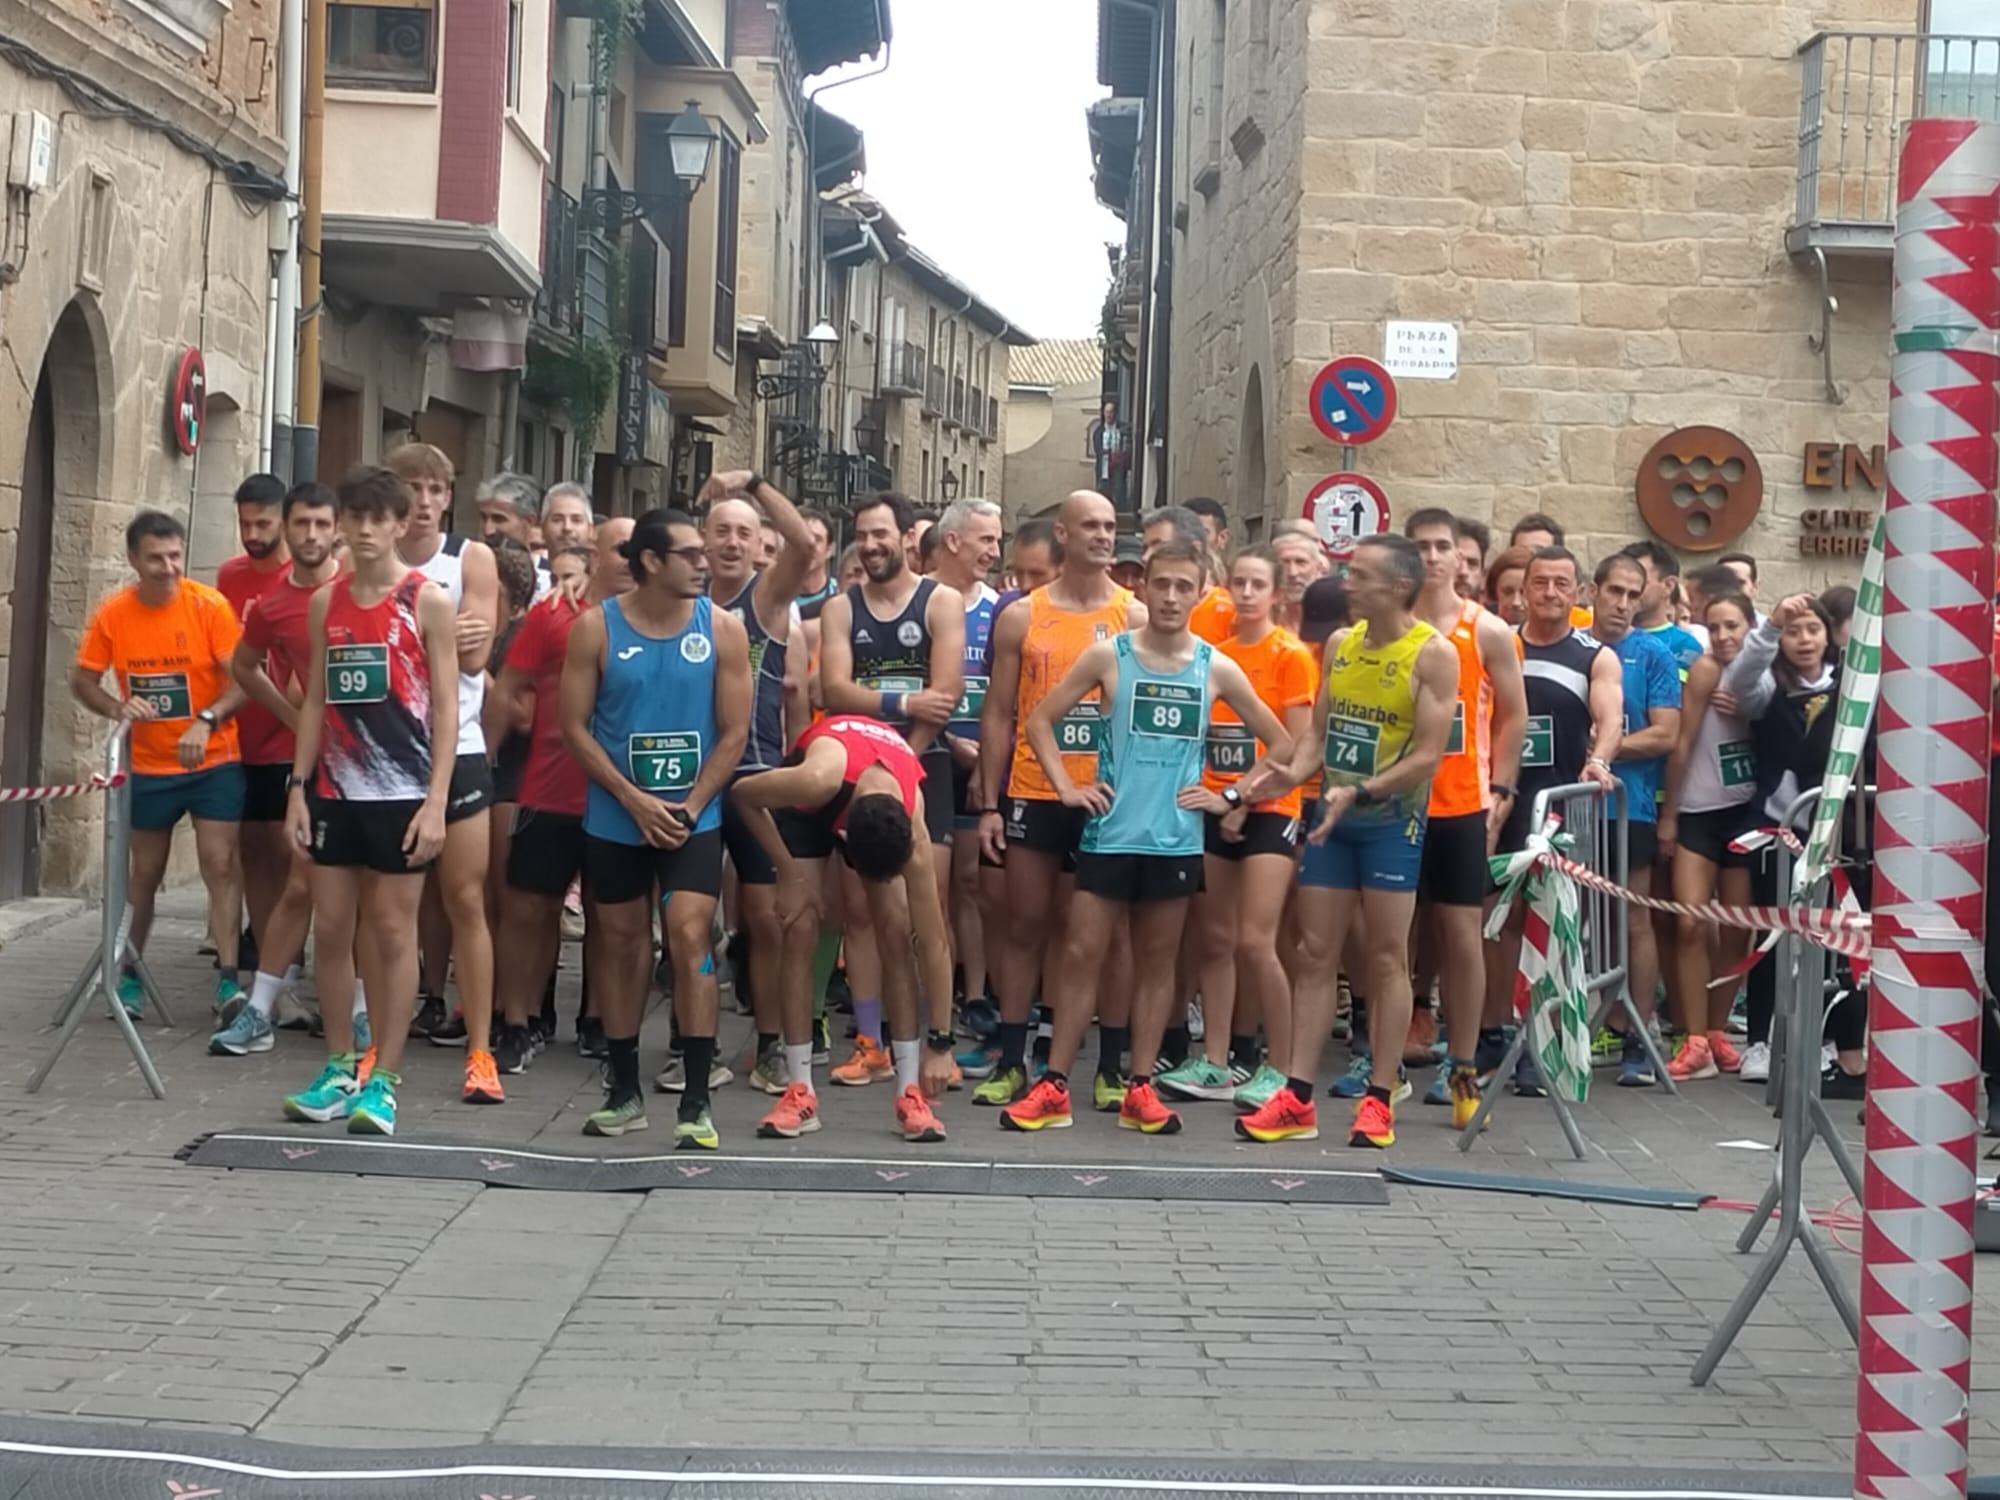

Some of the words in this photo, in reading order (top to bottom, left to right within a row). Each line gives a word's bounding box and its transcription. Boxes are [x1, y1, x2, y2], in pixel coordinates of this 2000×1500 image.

[1396, 330, 1448, 341] PLAZA
[1399, 345, 1412, 354] DE
[624, 355, 643, 462] PRENSA
[1803, 442, 1885, 489] EN
[339, 670, 368, 692] 99
[1152, 705, 1182, 728] 89
[1063, 724, 1091, 745] 86
[1213, 745, 1246, 766] 104
[1335, 741, 1359, 765] 74
[1521, 738, 1535, 758] 2
[651, 757, 682, 780] 75
